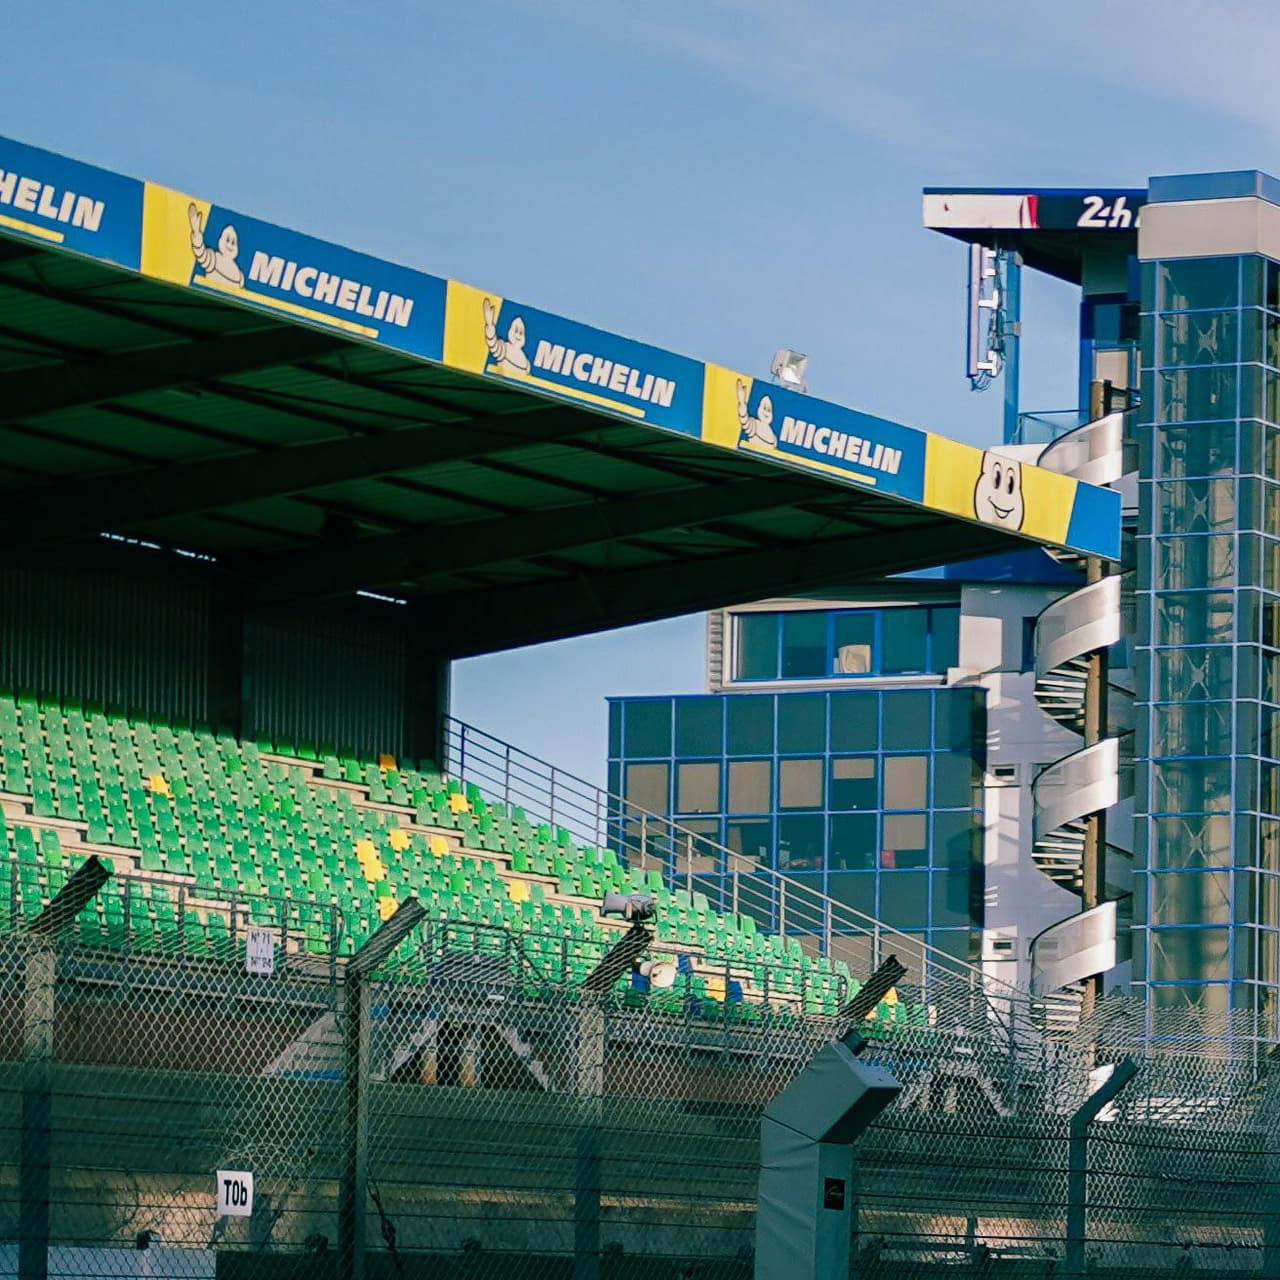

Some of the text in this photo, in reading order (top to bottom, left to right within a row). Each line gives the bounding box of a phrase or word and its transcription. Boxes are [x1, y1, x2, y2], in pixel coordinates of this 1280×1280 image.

[249, 251, 414, 327] MICHELIN
[534, 340, 675, 407] MICHELIN
[780, 417, 903, 475] MICHELIN
